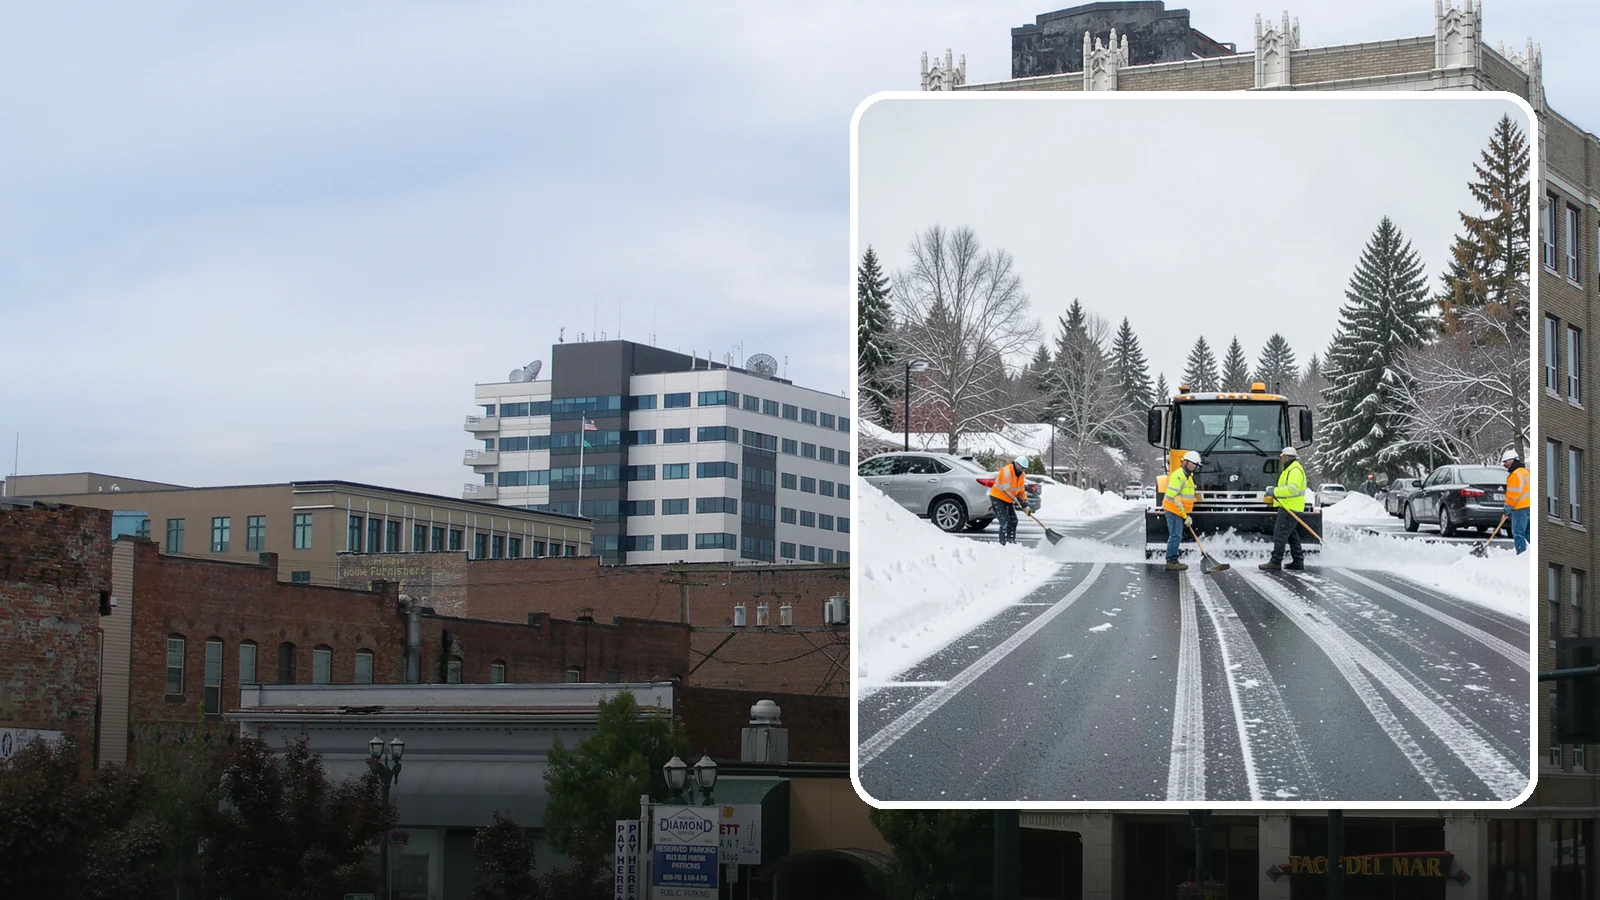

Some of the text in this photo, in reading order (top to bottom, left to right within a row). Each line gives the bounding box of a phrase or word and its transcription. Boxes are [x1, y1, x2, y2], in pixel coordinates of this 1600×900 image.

[343, 566, 427, 577] Home Furnishers
[660, 818, 713, 832] DIAMOND
[1022, 815, 1070, 828] BUILDING
[720, 824, 740, 836] ETT
[656, 845, 688, 853] RESERVED
[720, 839, 740, 849] ANT
[616, 824, 625, 893] PAY HERE
[627, 824, 637, 893] PAY HERE
[722, 851, 739, 862] Soup
[671, 862, 700, 870] PATRONS
[1346, 856, 1385, 876] DEL
[1392, 857, 1443, 877] MAR
[660, 888, 710, 898] PUBLIC PARKING
